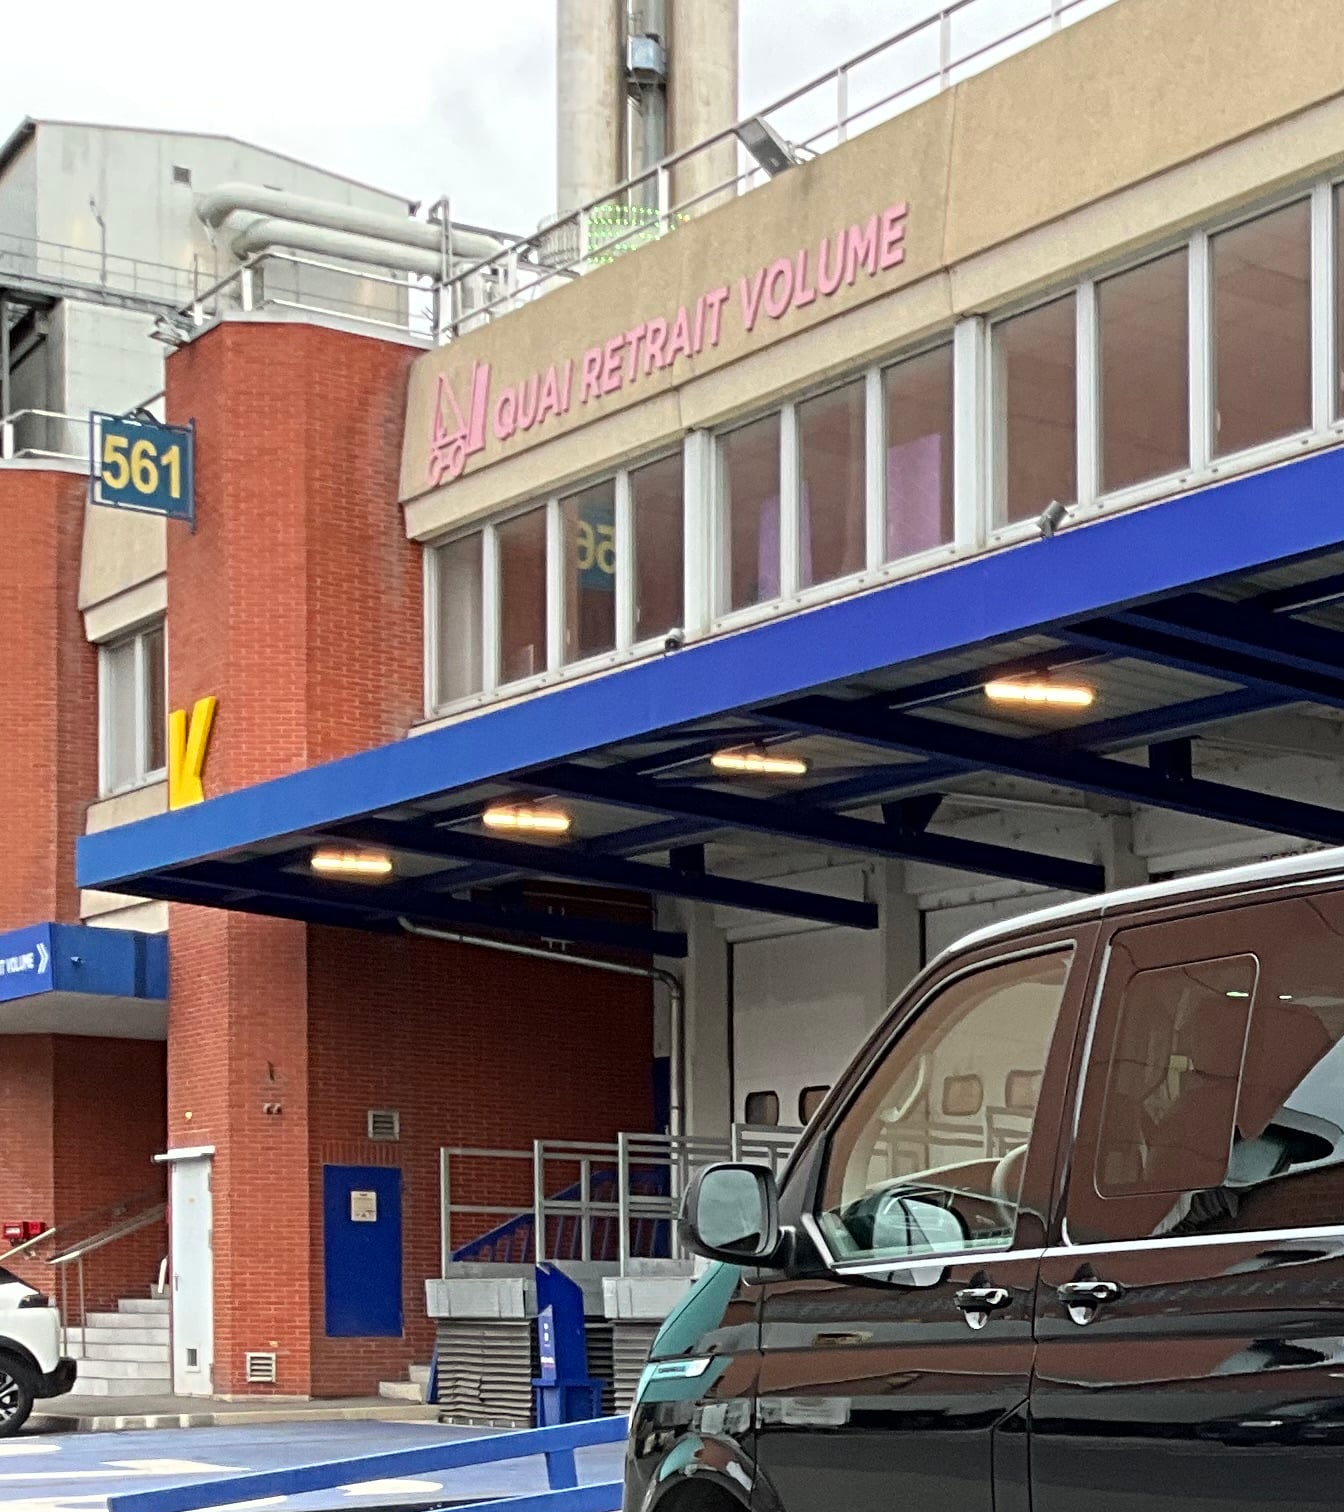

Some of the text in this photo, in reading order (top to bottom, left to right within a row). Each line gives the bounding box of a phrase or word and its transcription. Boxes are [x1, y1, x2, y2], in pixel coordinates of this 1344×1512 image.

[493, 202, 909, 440] QUAI RETRAIT VOLUME
[102, 435, 181, 498] 561
